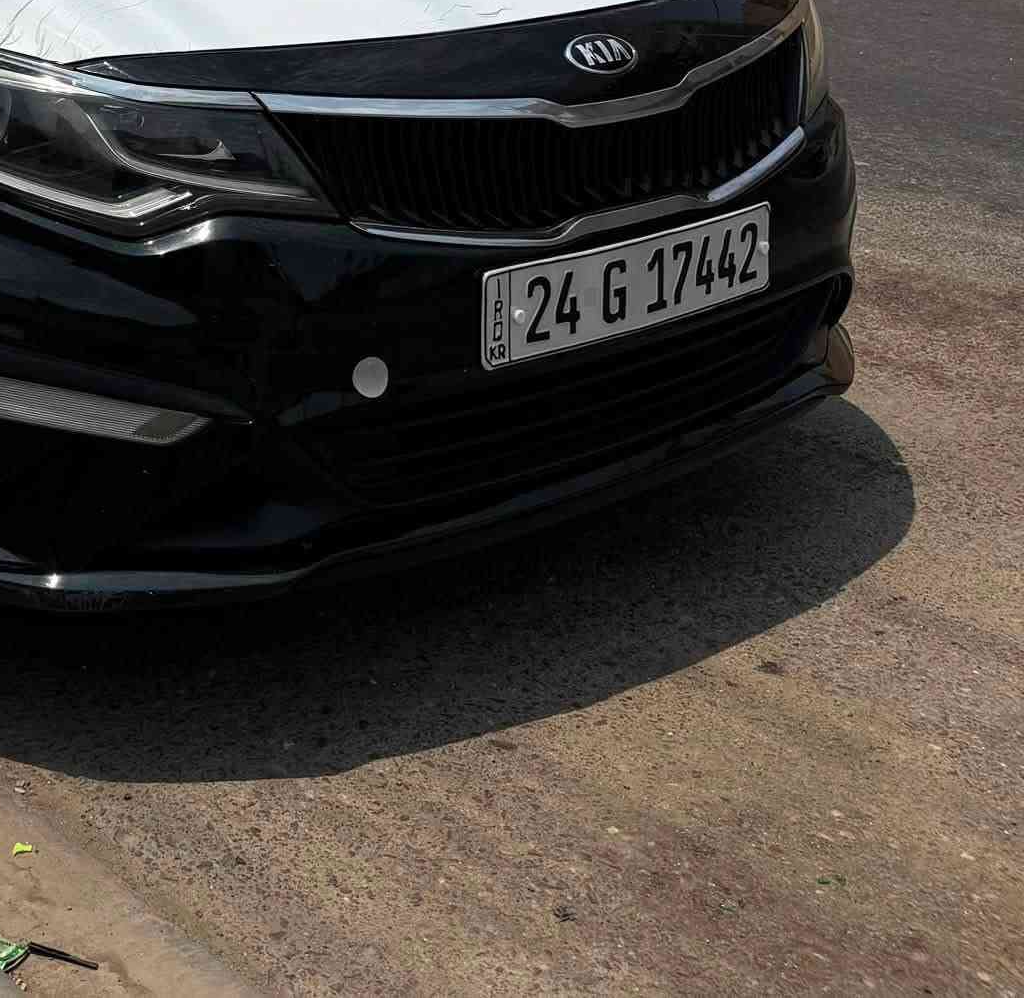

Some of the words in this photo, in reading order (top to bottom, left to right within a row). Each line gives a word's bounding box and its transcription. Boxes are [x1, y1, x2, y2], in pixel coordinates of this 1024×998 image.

[575, 38, 632, 66] KIA
[525, 270, 581, 344] 24
[601, 258, 628, 324] G
[646, 221, 759, 315] 17442
